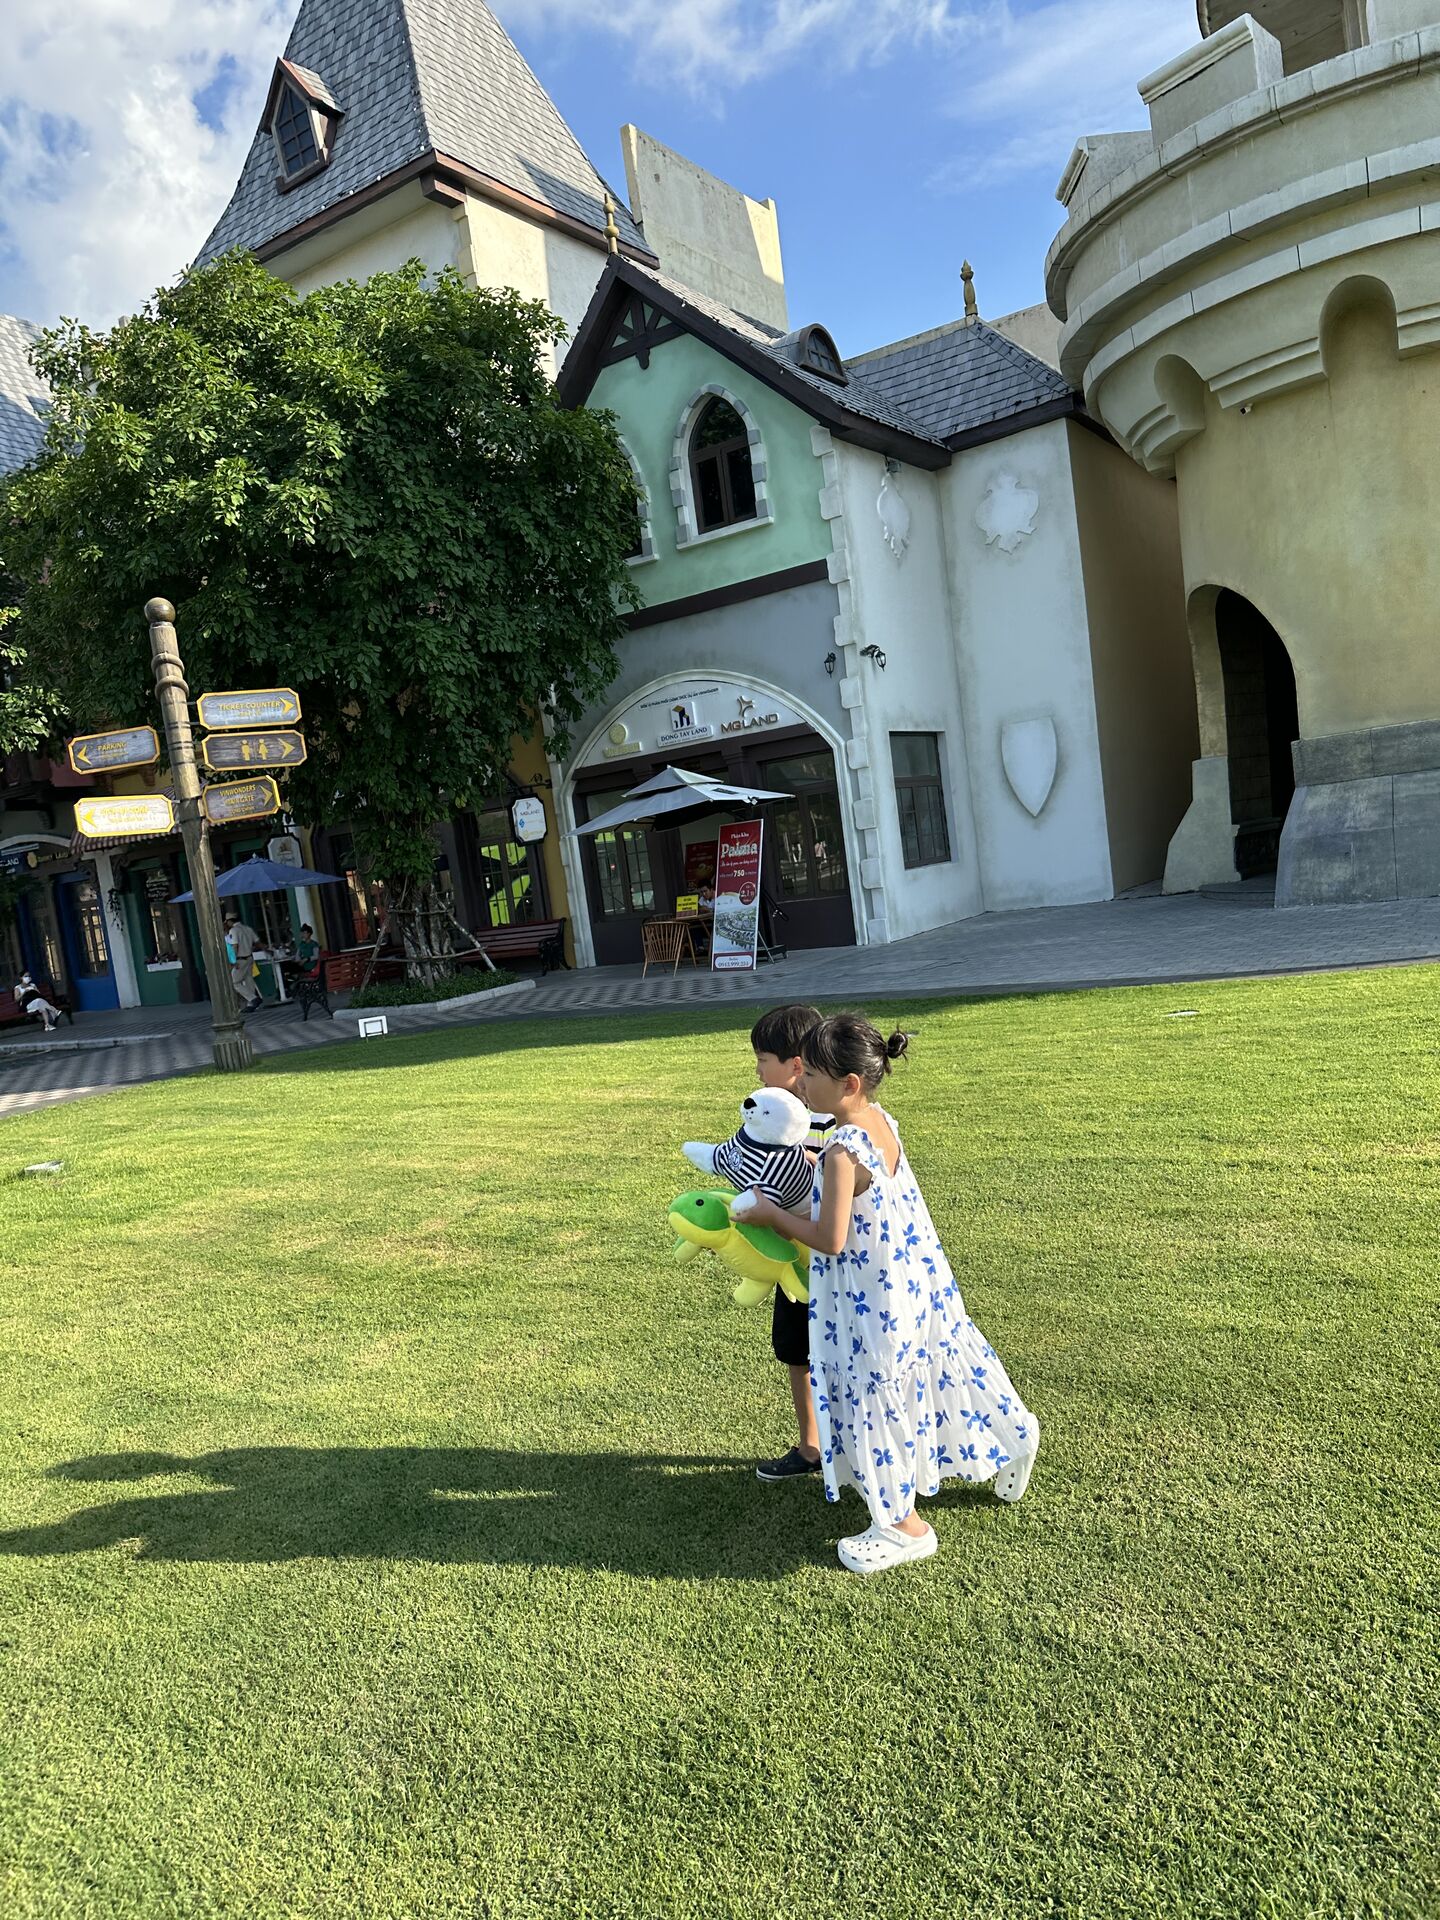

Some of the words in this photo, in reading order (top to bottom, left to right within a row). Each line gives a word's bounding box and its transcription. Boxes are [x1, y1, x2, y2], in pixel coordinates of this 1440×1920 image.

[218, 703, 244, 712] TICKET
[246, 700, 281, 710] COUNTER
[720, 713, 778, 734] MGLAND
[680, 730, 690, 738] TAY
[691, 727, 708, 736] LAND
[96, 742, 127, 751] PARKING
[220, 784, 256, 796] VINWONDERS
[240, 794, 255, 803] GATE
[733, 870, 745, 878] 750
